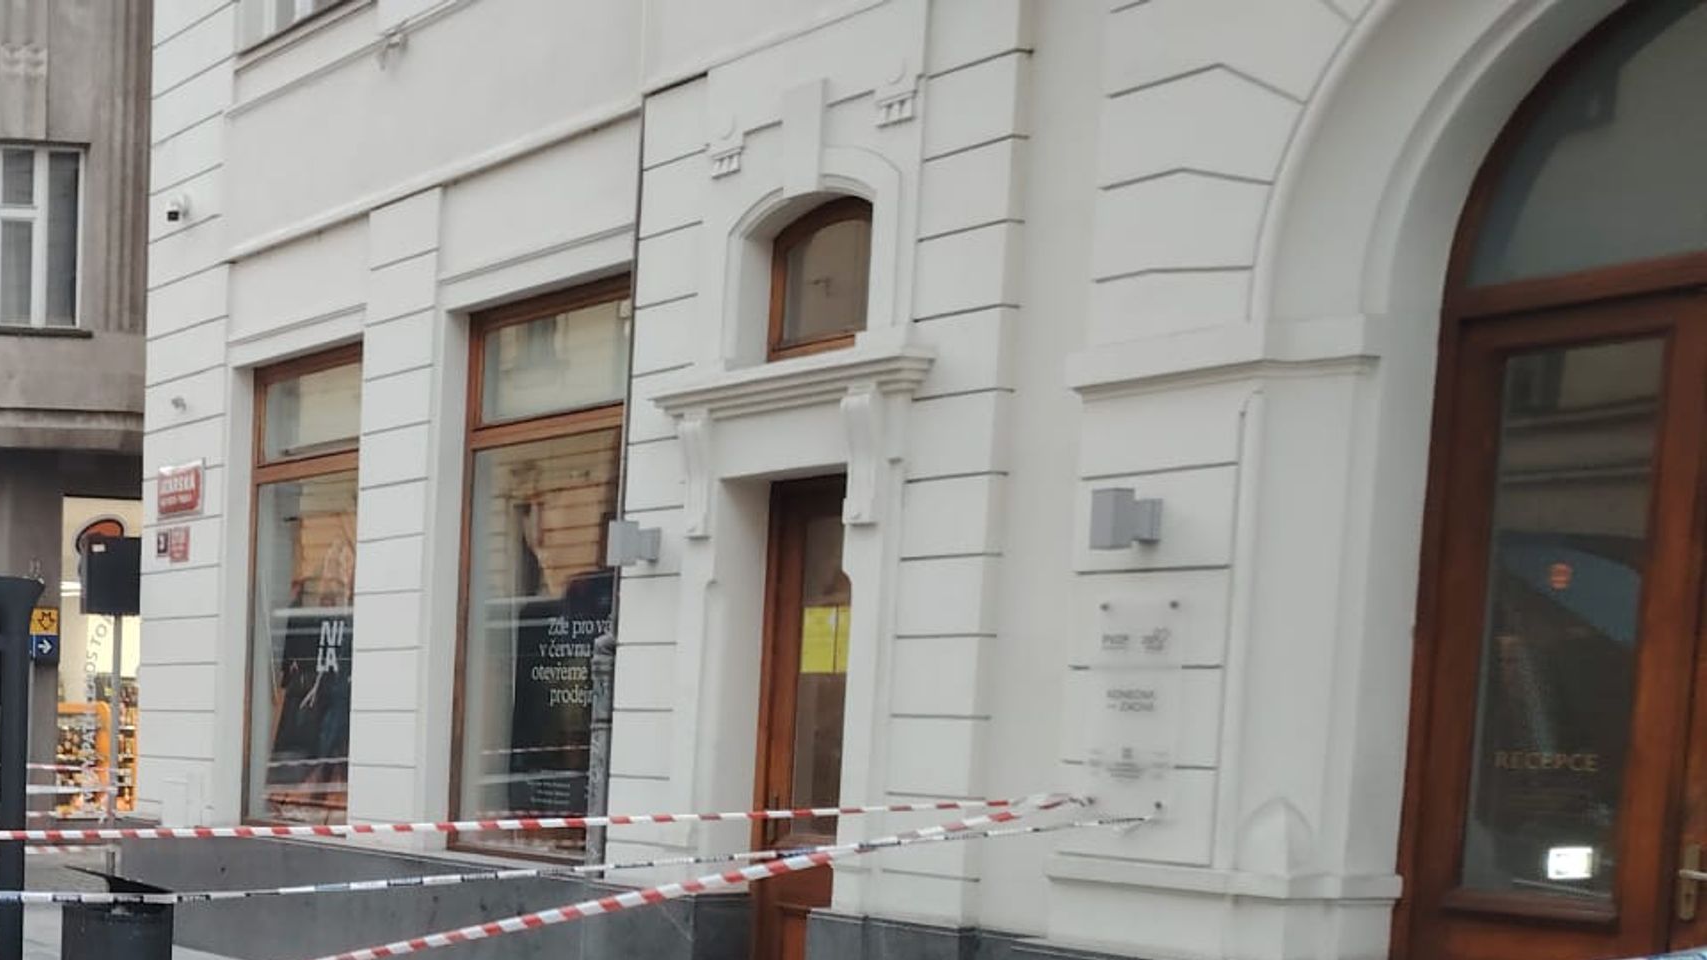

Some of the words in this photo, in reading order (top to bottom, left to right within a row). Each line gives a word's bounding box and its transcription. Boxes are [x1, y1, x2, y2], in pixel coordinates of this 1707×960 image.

[548, 616, 569, 636] Zde
[572, 620, 593, 638] pro
[539, 643, 548, 657] v
[548, 639, 591, 657] červnu
[532, 661, 588, 681] otevřeme
[1494, 750, 1599, 772] RECEPCE
